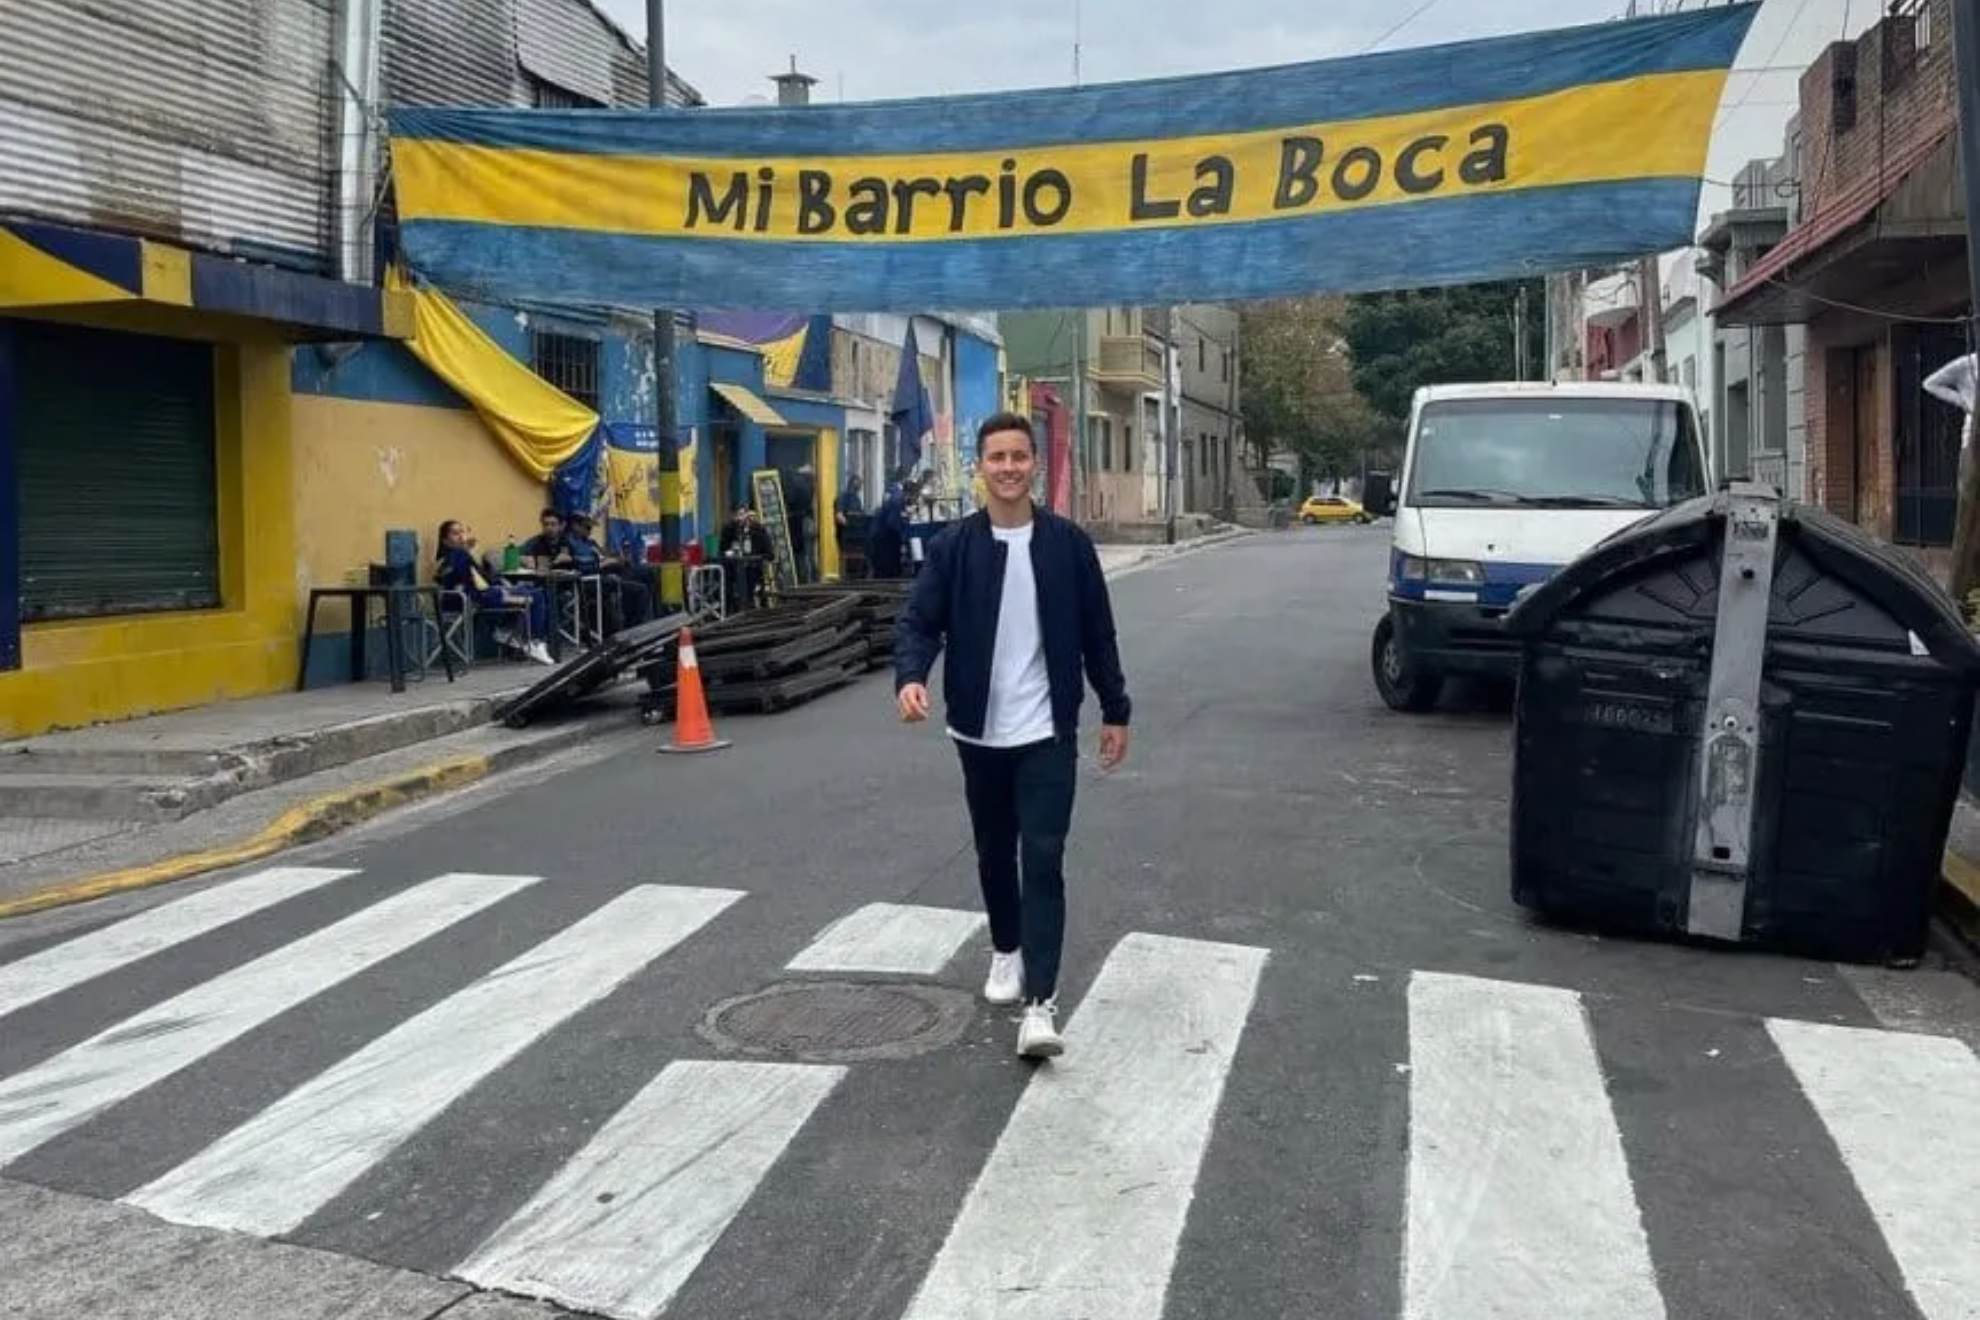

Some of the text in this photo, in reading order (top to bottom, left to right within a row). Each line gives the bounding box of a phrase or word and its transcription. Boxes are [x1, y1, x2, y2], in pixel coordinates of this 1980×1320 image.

[684, 124, 1509, 236] Mi Barrio La Boca
